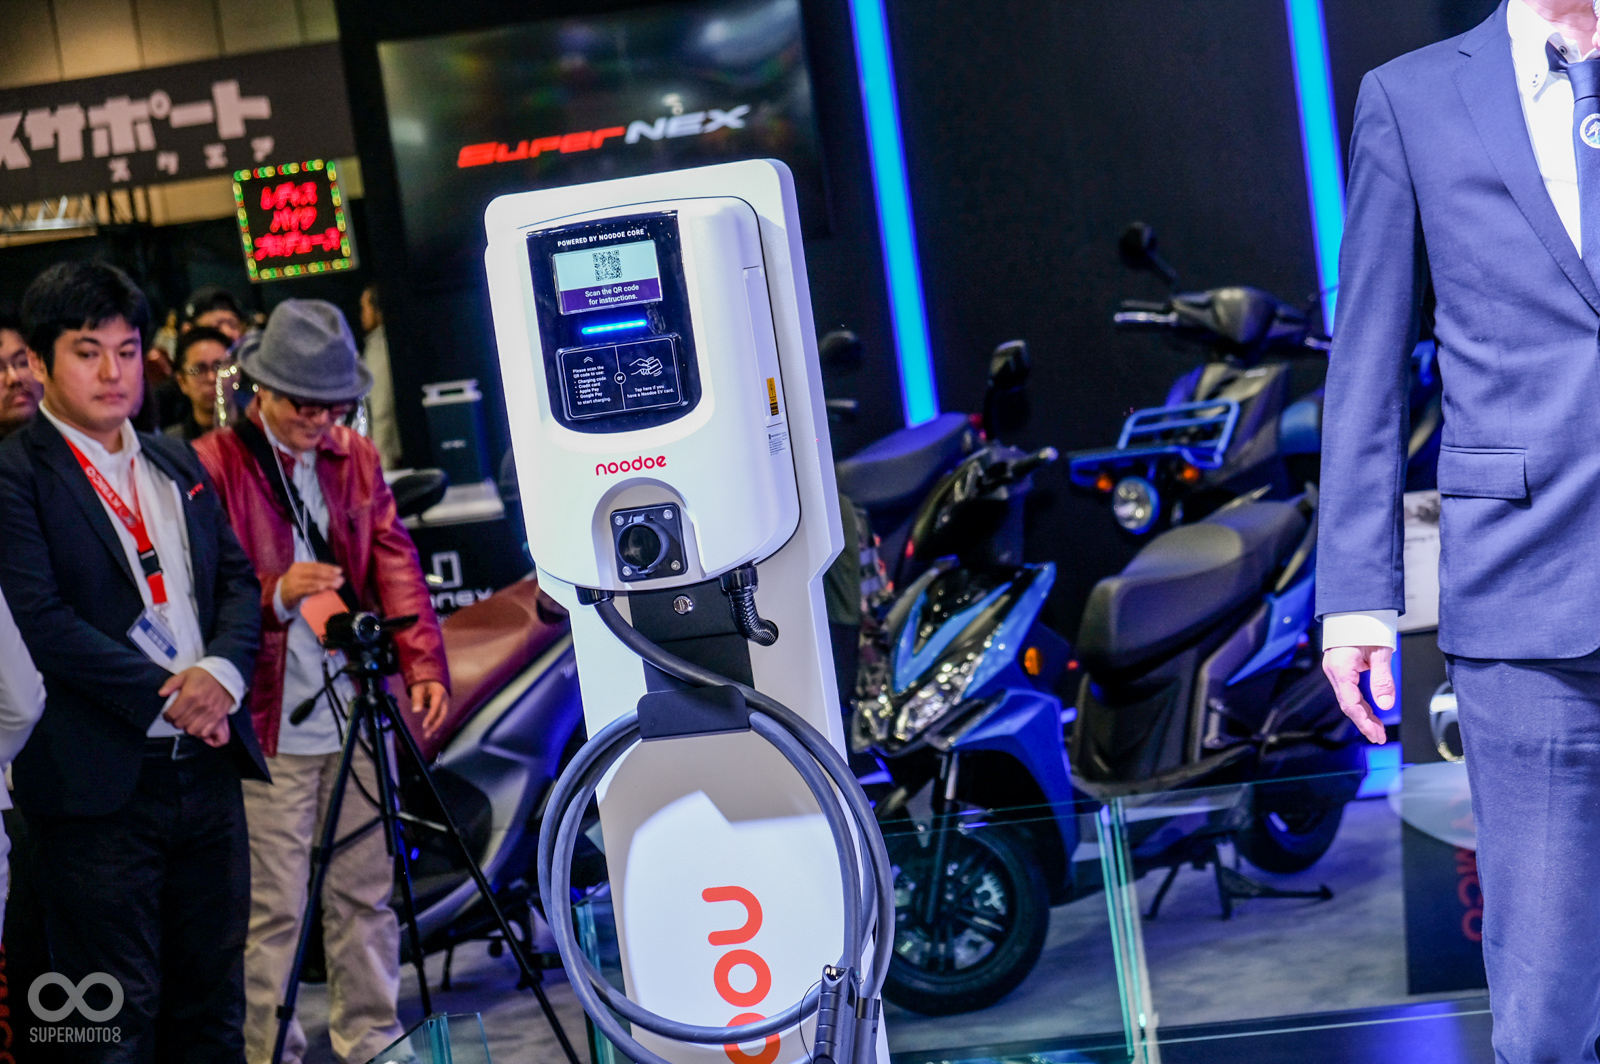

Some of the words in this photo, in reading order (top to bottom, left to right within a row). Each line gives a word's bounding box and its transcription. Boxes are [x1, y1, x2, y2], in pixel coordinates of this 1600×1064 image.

[557, 237, 587, 247] POWERED
[588, 235, 598, 243] BY
[598, 231, 626, 241] NOODOE
[627, 228, 645, 237] CORE
[584, 290, 601, 298] Scan
[601, 287, 612, 295] the
[612, 286, 623, 294] QR
[623, 284, 640, 292] code
[588, 298, 598, 306] for
[598, 293, 638, 304] instructions.
[592, 396, 611, 404] charging.
[595, 455, 667, 476] noodoe
